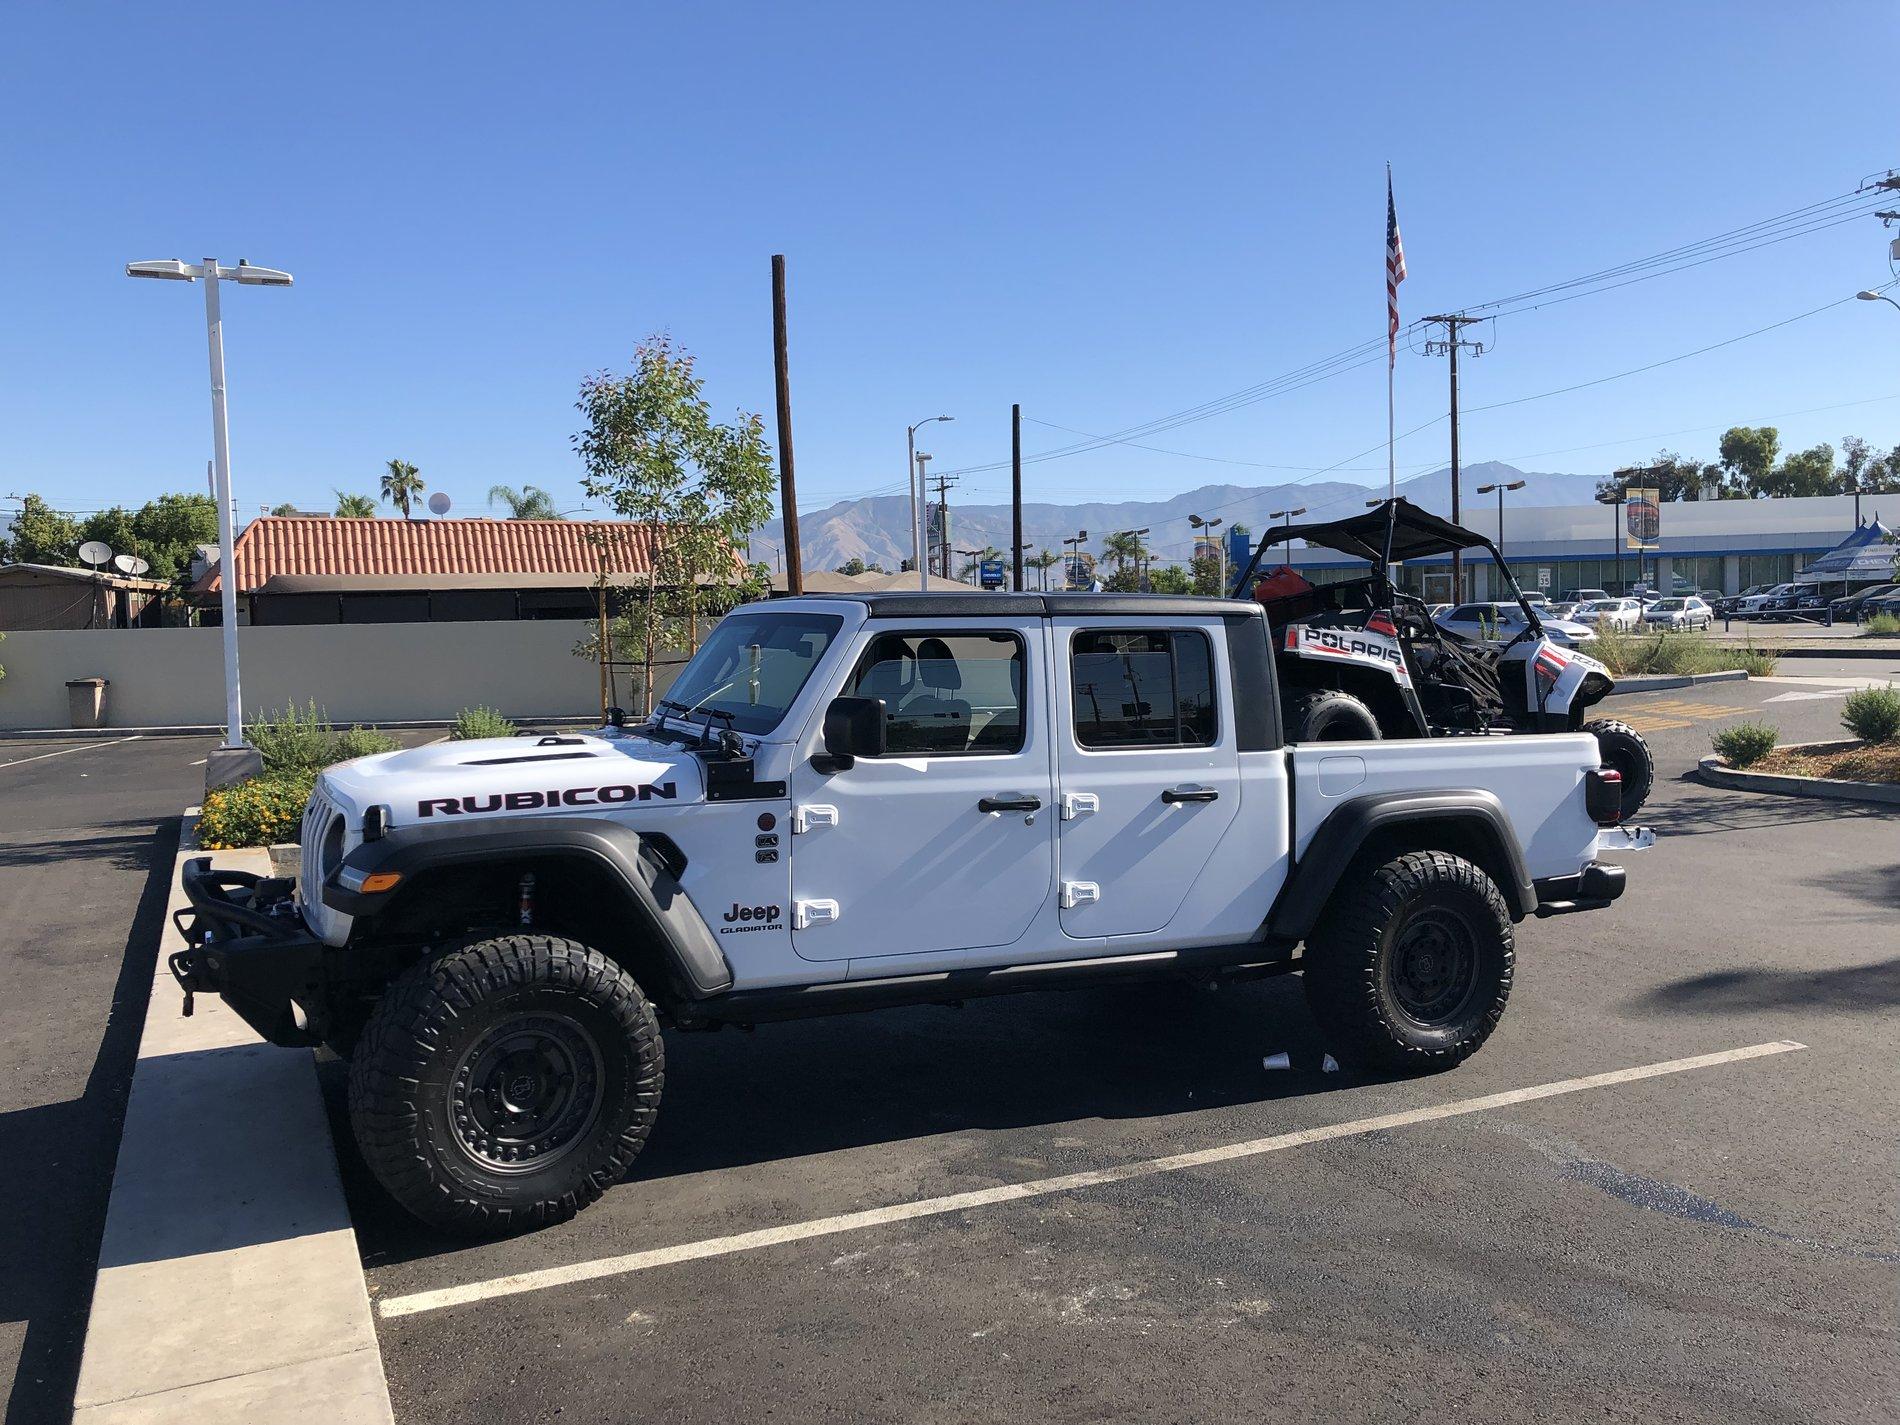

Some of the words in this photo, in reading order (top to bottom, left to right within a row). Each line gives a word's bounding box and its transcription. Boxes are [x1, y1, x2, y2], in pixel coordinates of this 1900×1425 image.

[1540, 577, 1550, 586] 35
[1305, 629, 1402, 665] POLARIS
[418, 782, 677, 817] RUBICON
[724, 903, 780, 923] Jeep
[720, 924, 783, 934] GLADIATOR
